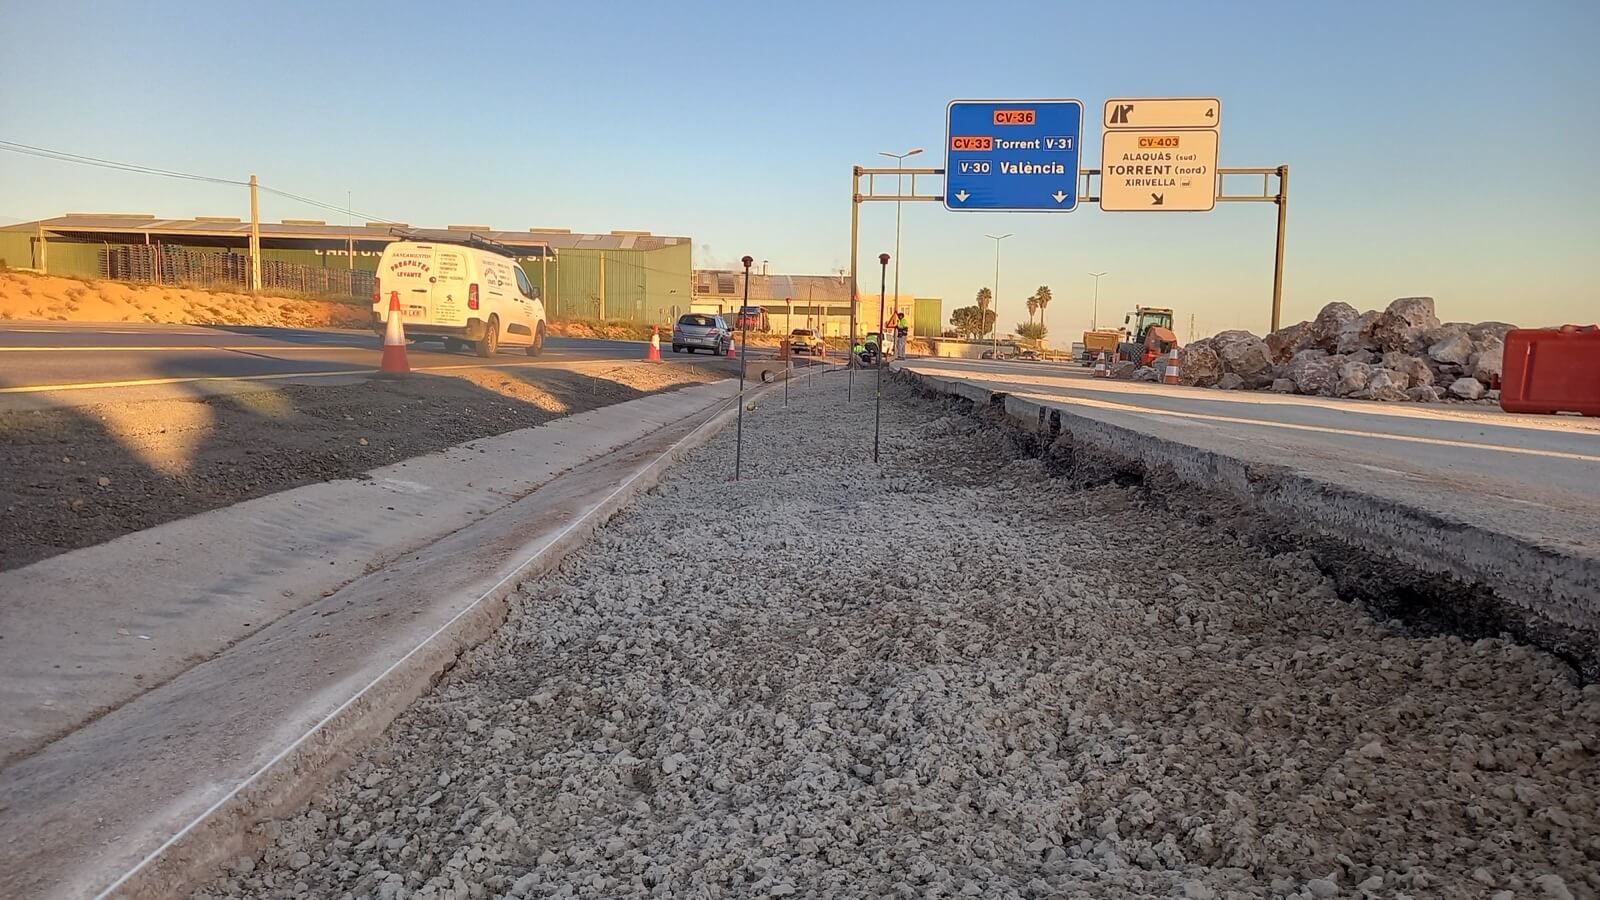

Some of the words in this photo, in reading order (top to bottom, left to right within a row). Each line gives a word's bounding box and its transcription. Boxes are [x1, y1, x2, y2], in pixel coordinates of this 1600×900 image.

[995, 112, 1034, 123] CV-36
[1205, 108, 1214, 118] 4
[953, 138, 991, 149] CV-33
[994, 138, 1041, 149] Torrent
[1045, 138, 1073, 149] V-31
[1139, 138, 1180, 147] CV-403
[1122, 151, 1172, 162] ALAQUÀS
[1175, 154, 1197, 162] (sud)
[961, 162, 990, 173] V-30
[1000, 161, 1065, 174] València
[1108, 165, 1172, 175] TORRENT
[1174, 165, 1207, 176] (nord)
[1125, 179, 1176, 187] XIRIVELLA
